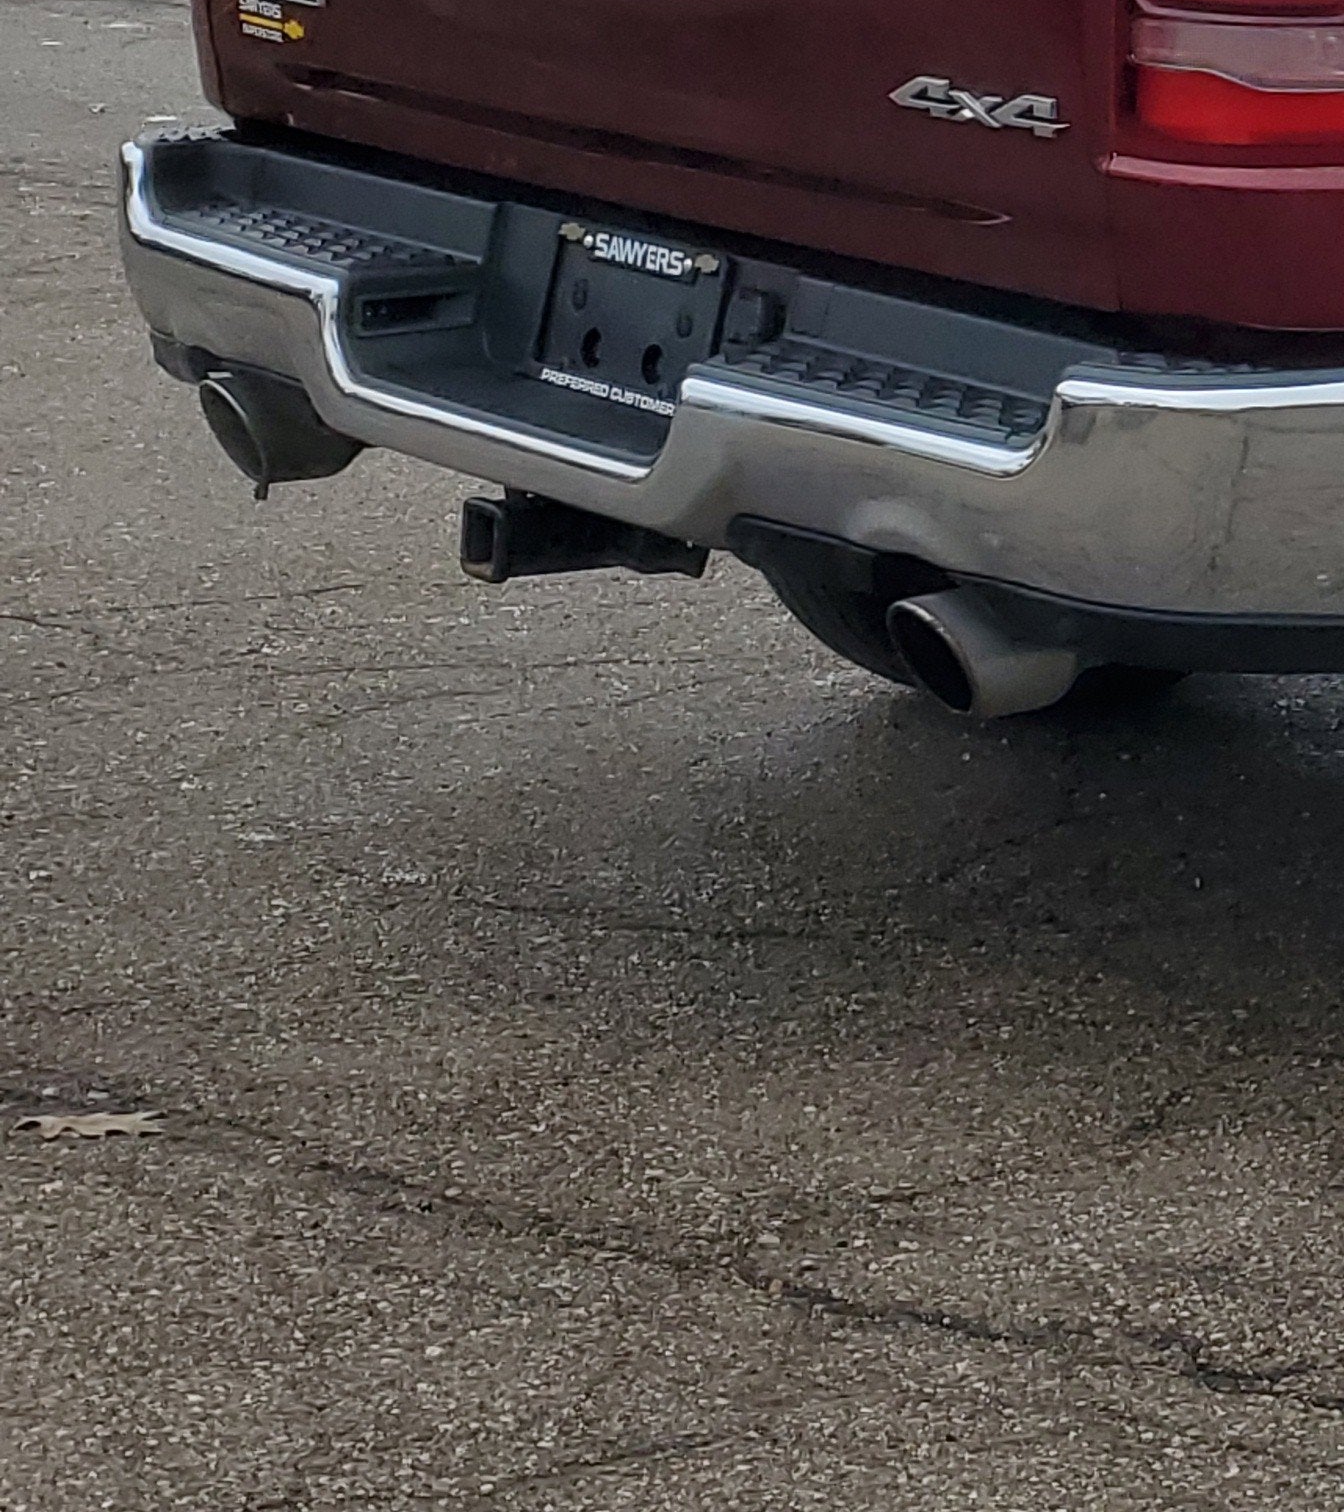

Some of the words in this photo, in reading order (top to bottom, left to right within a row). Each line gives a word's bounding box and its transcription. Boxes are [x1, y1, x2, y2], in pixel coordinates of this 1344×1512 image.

[594, 232, 685, 276] SAWYERS
[540, 367, 610, 398] PREFERRED
[610, 387, 676, 417] CUSTOMER
